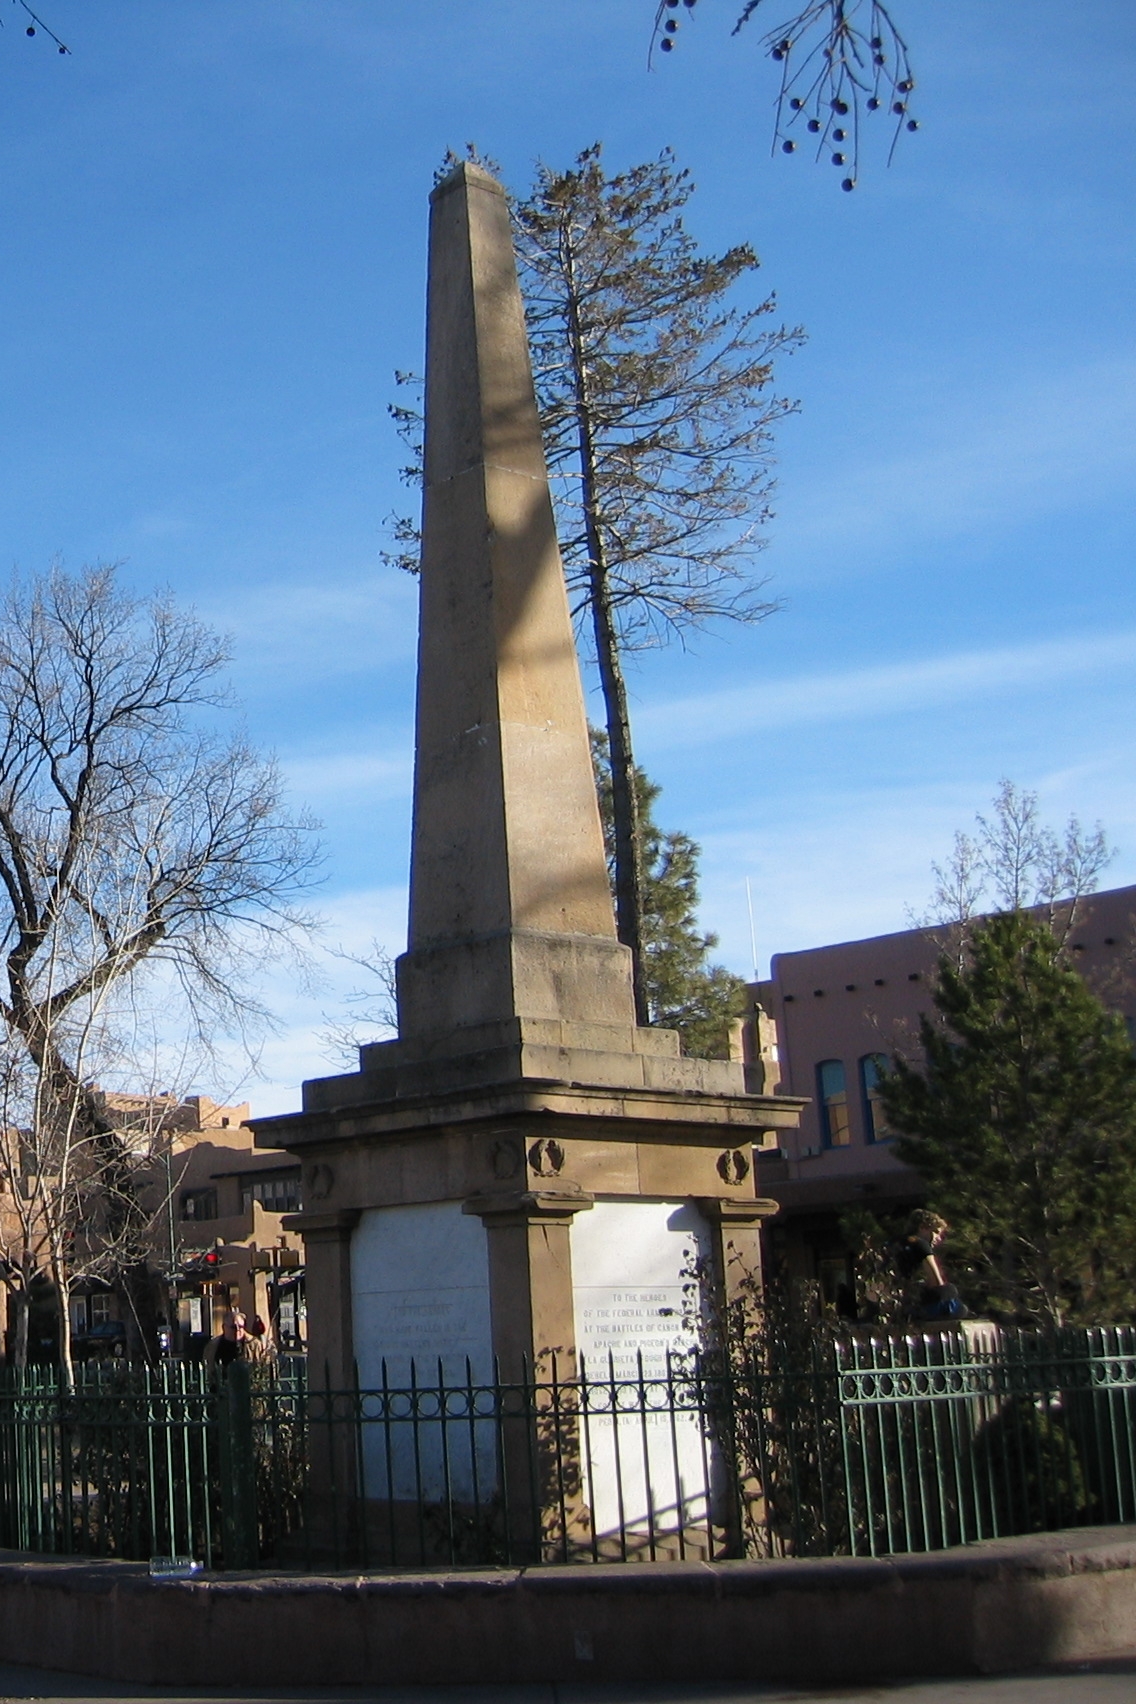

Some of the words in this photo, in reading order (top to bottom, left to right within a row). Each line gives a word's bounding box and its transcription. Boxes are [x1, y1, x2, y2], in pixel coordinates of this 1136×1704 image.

[612, 1294, 622, 1302] TO
[583, 1309, 593, 1318] OF
[597, 1309, 610, 1318] THE
[612, 1309, 644, 1318] FEDERAL
[584, 1325, 593, 1333] AT
[596, 1325, 610, 1334] THE
[612, 1324, 643, 1333] BATTLES
[645, 1324, 655, 1332] OF
[624, 1339, 637, 1347] AND
